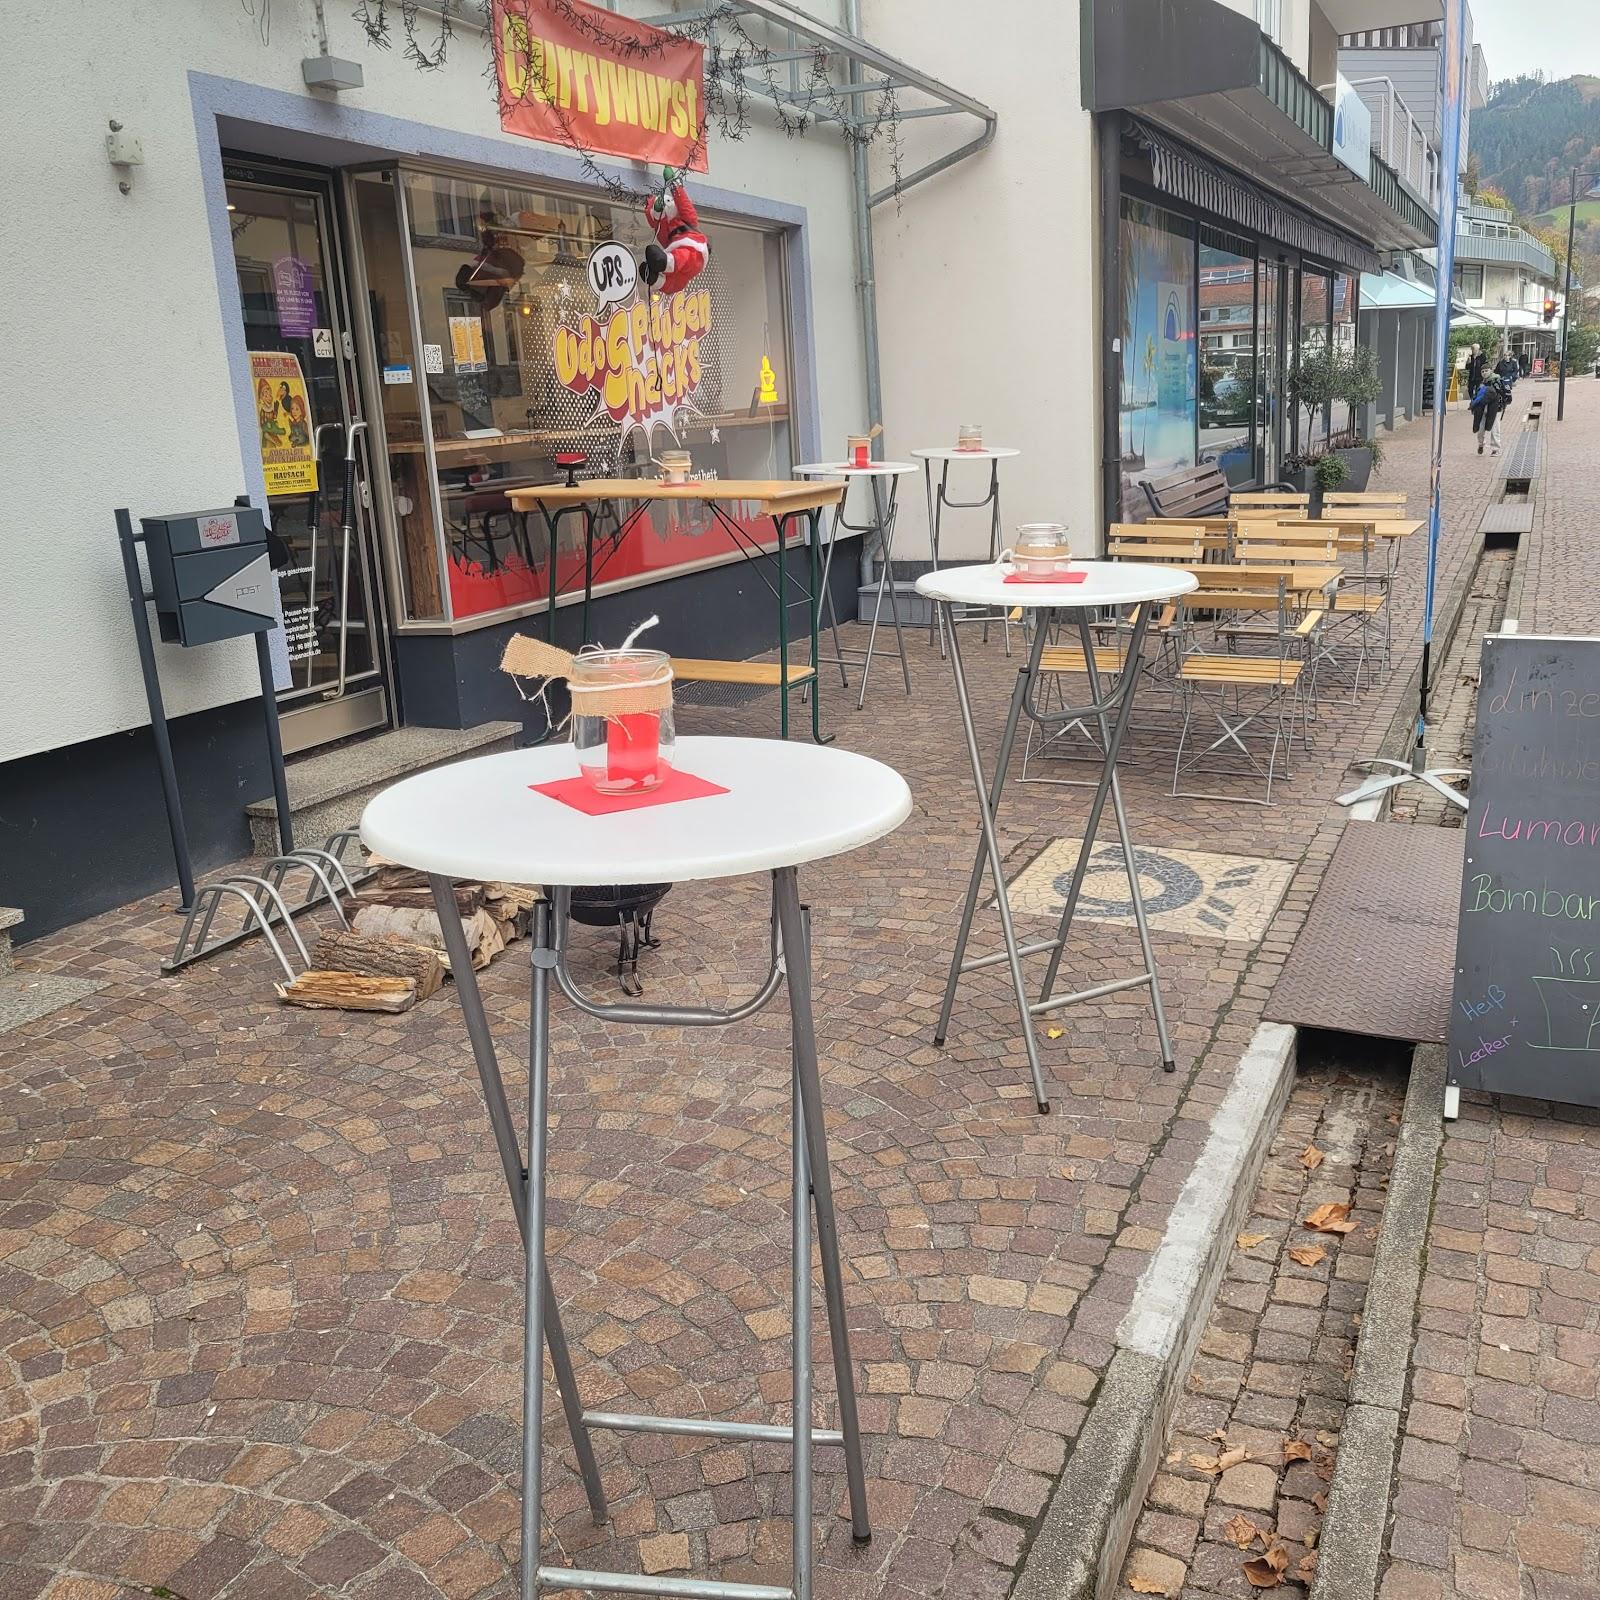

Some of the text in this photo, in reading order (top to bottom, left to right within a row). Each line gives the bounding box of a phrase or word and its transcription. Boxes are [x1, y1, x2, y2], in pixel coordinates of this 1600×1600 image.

[503, 14, 699, 142] Currywurst
[316, 348, 332, 356] CCTV
[273, 471, 305, 480] HAUSACH
[1458, 1034, 1513, 1069] Lecker
